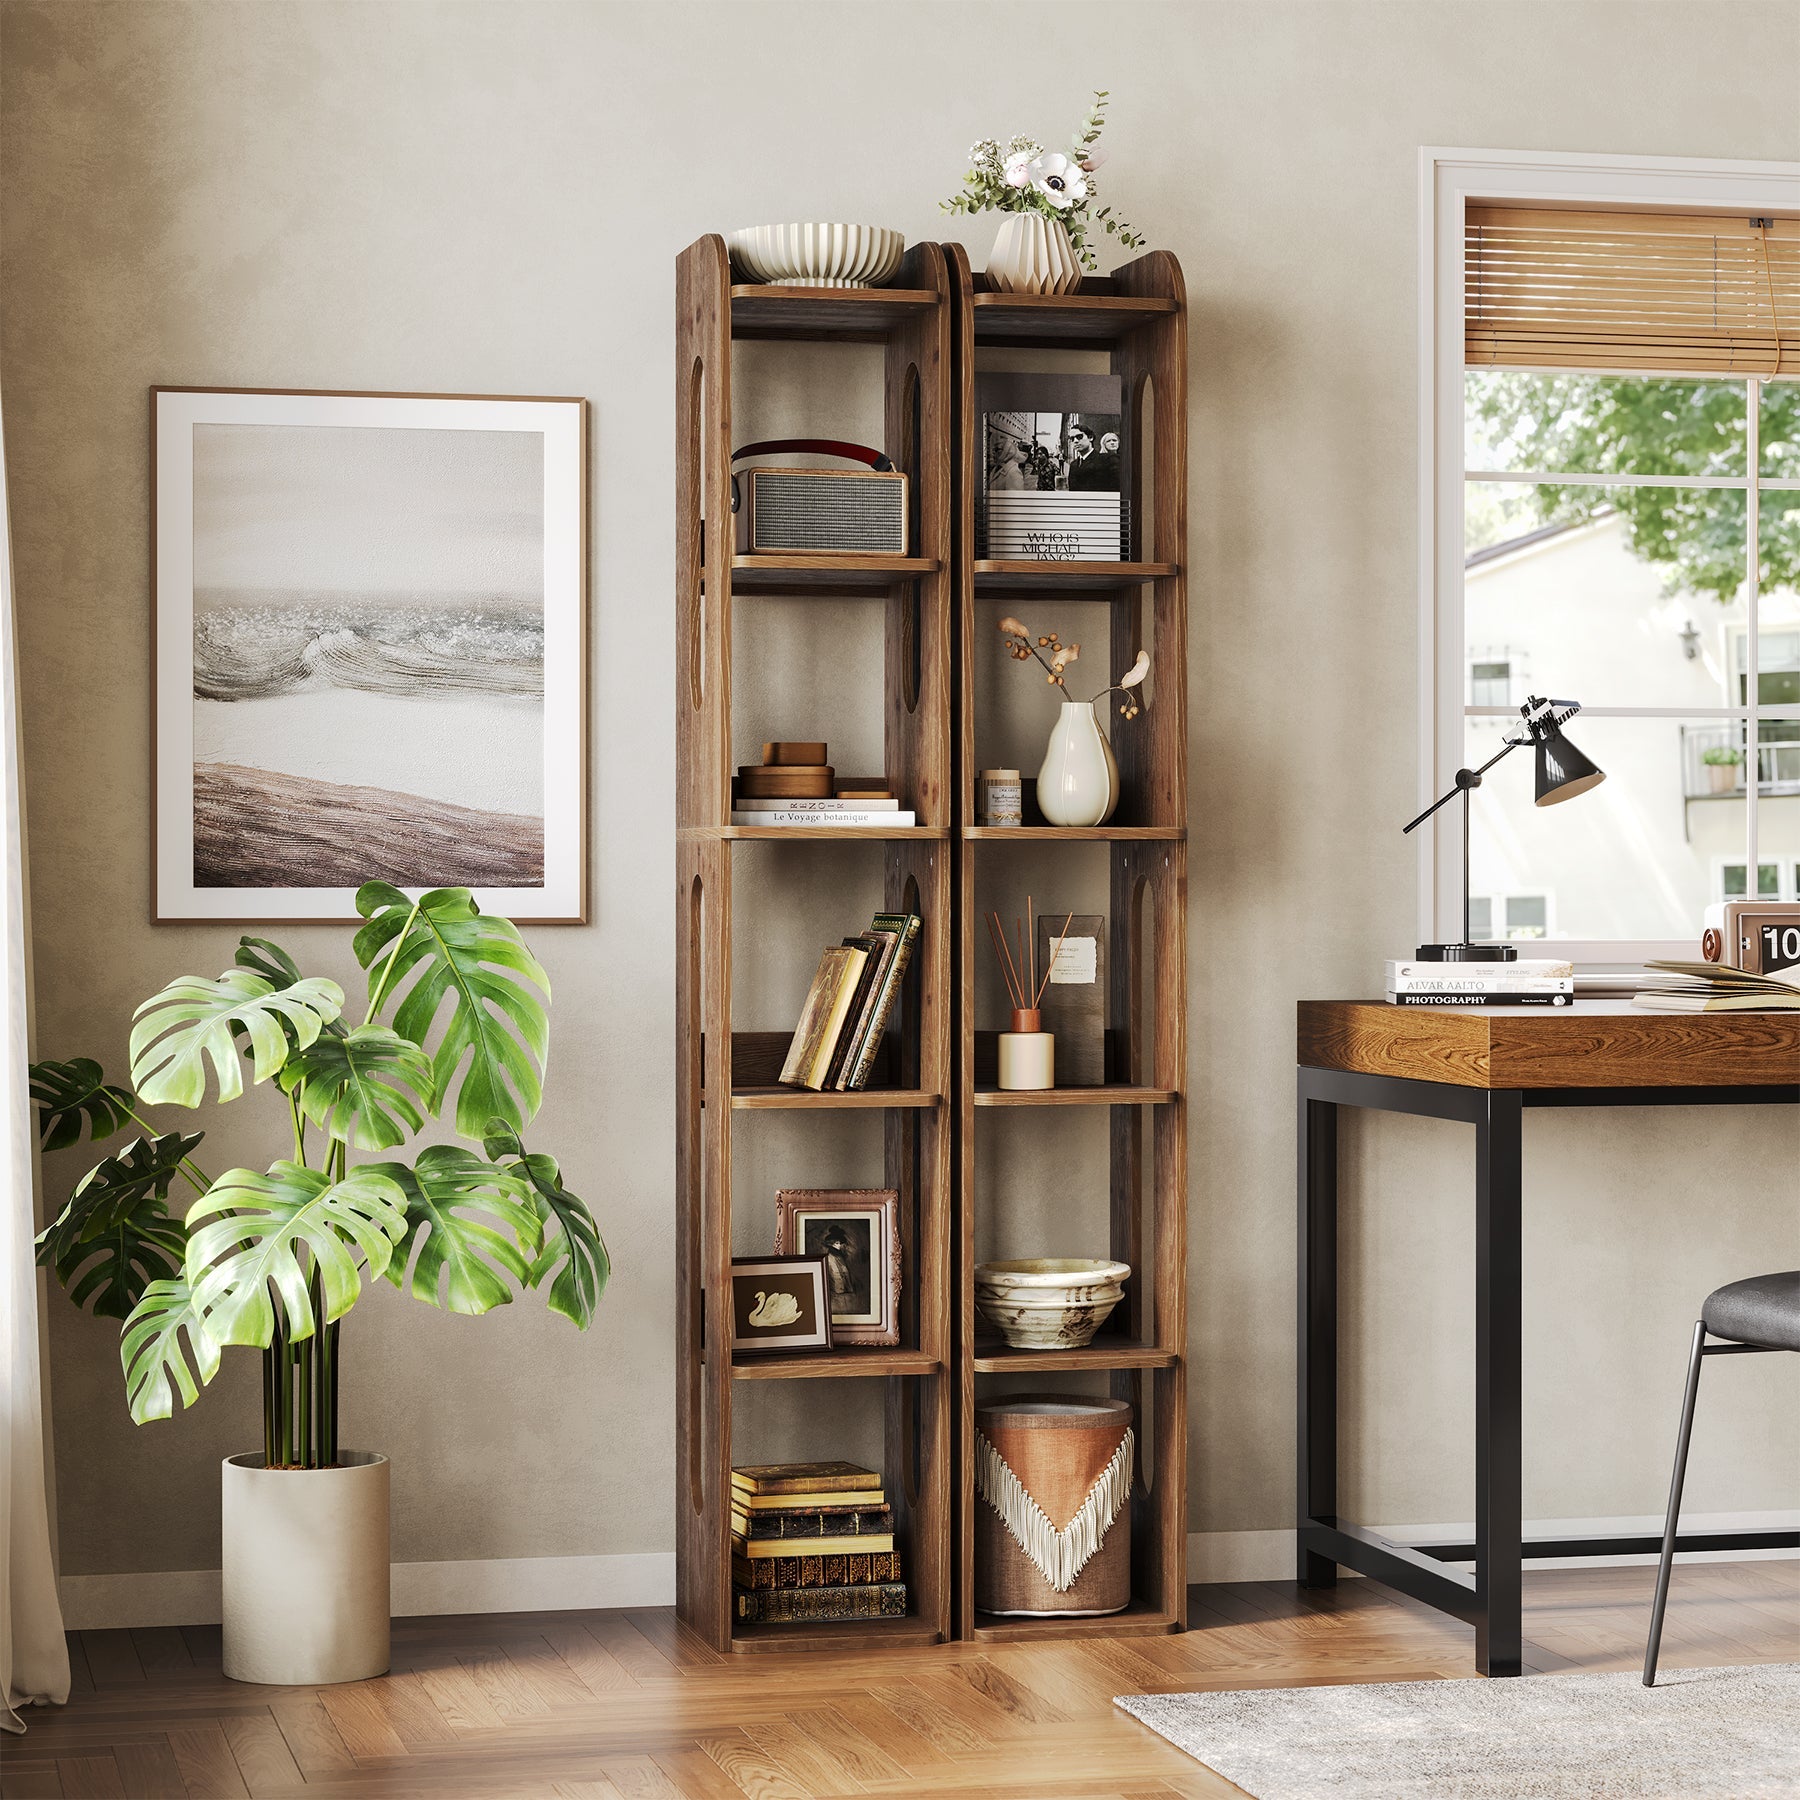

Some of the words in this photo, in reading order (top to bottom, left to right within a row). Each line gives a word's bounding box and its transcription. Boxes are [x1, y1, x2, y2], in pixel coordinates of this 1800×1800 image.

[1027, 532, 1064, 543] WHO
[1066, 533, 1079, 543] IS
[1022, 543, 1086, 554] MICHAEL
[774, 812, 785, 821] Le
[788, 813, 821, 823] Voyage
[824, 813, 869, 823] botanique
[1764, 927, 1800, 960] 10
[1407, 981, 1445, 990] ALVAR
[1446, 981, 1485, 990] AALTO
[1405, 996, 1487, 1004] PHOTOGRAPHY
